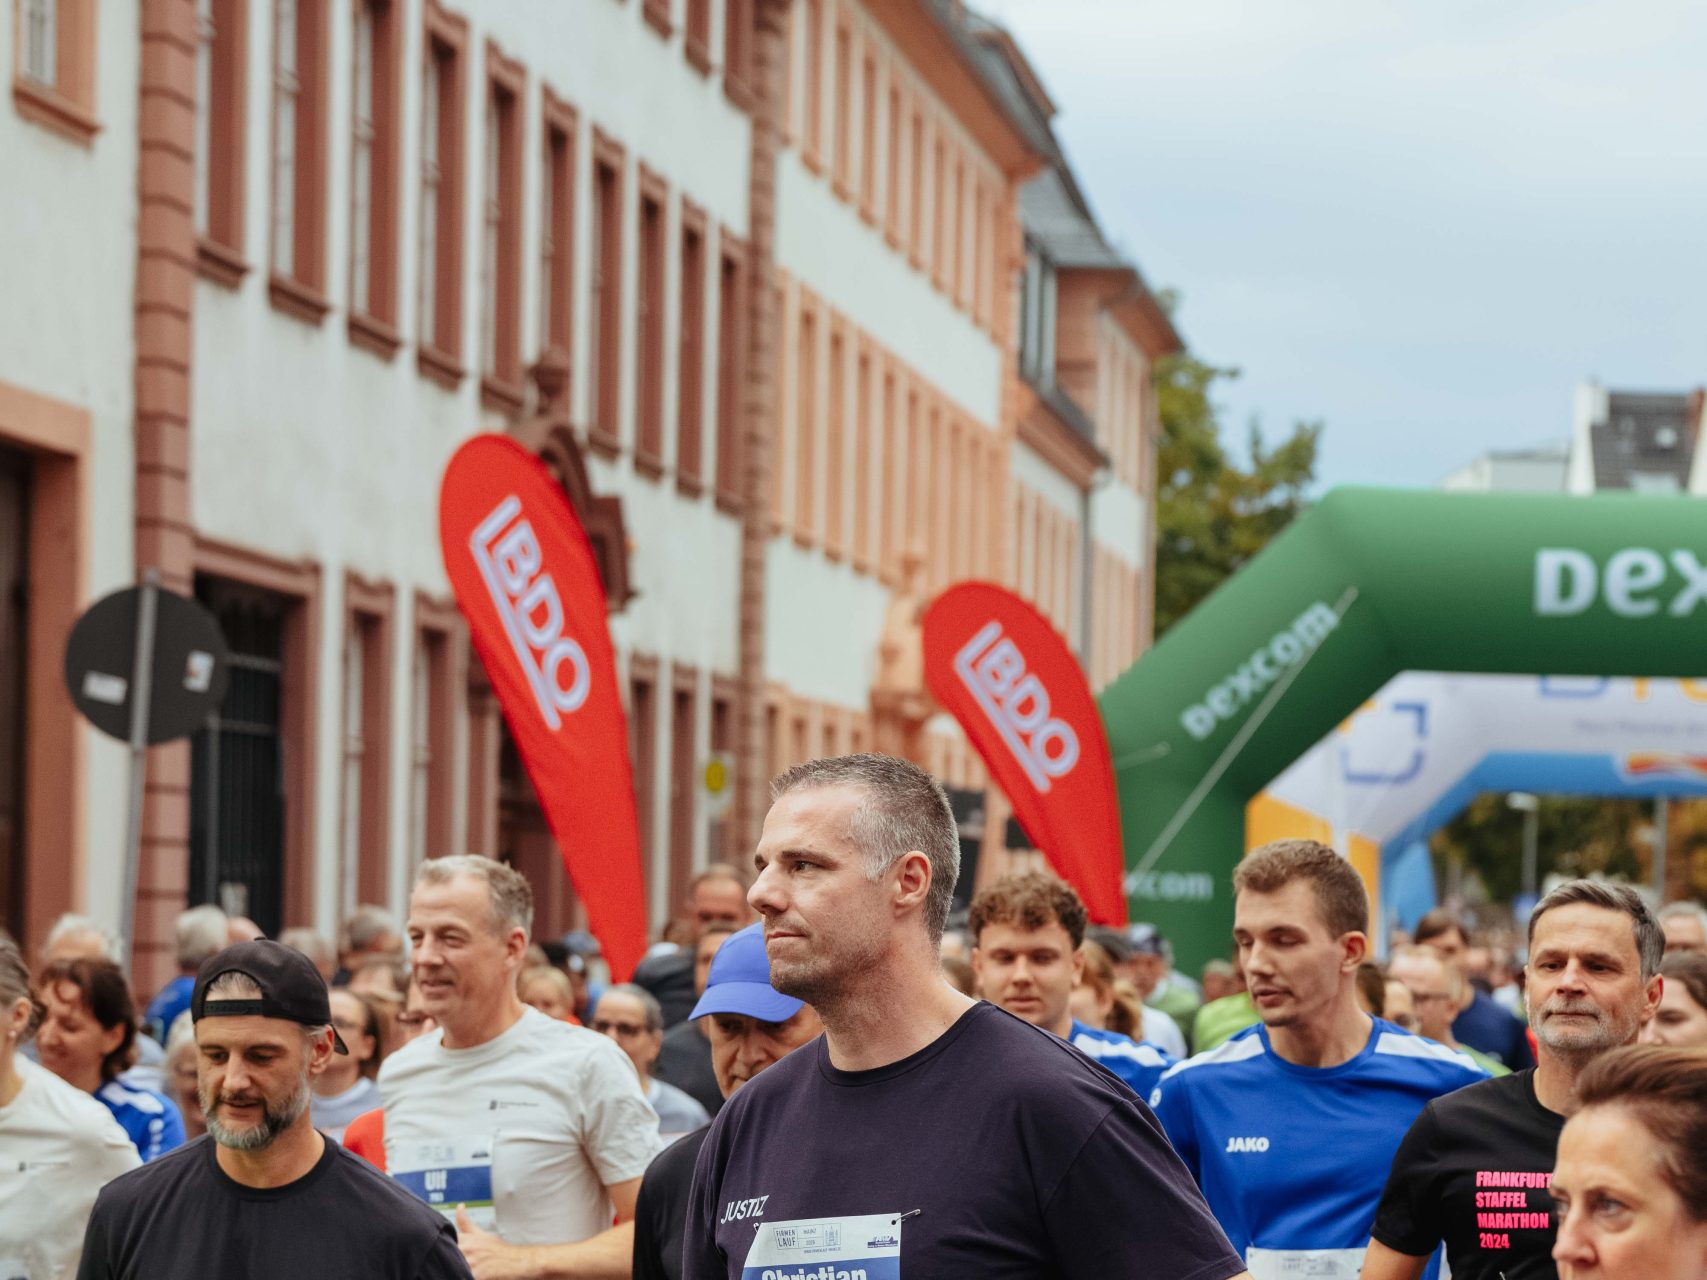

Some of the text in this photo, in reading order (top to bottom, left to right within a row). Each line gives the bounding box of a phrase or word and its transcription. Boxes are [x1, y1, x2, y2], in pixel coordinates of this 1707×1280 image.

[488, 514, 592, 714] BDO
[972, 634, 1081, 779] BDO
[1225, 1136, 1270, 1153] JAKO
[1475, 1171, 1554, 1189] FRANKFURT
[1475, 1191, 1528, 1209] STAFFEL
[720, 1194, 770, 1225] JUSTIZ
[1477, 1212, 1550, 1230] MARATHON
[777, 1236, 797, 1248] LAUF
[1479, 1233, 1511, 1249] 2024
